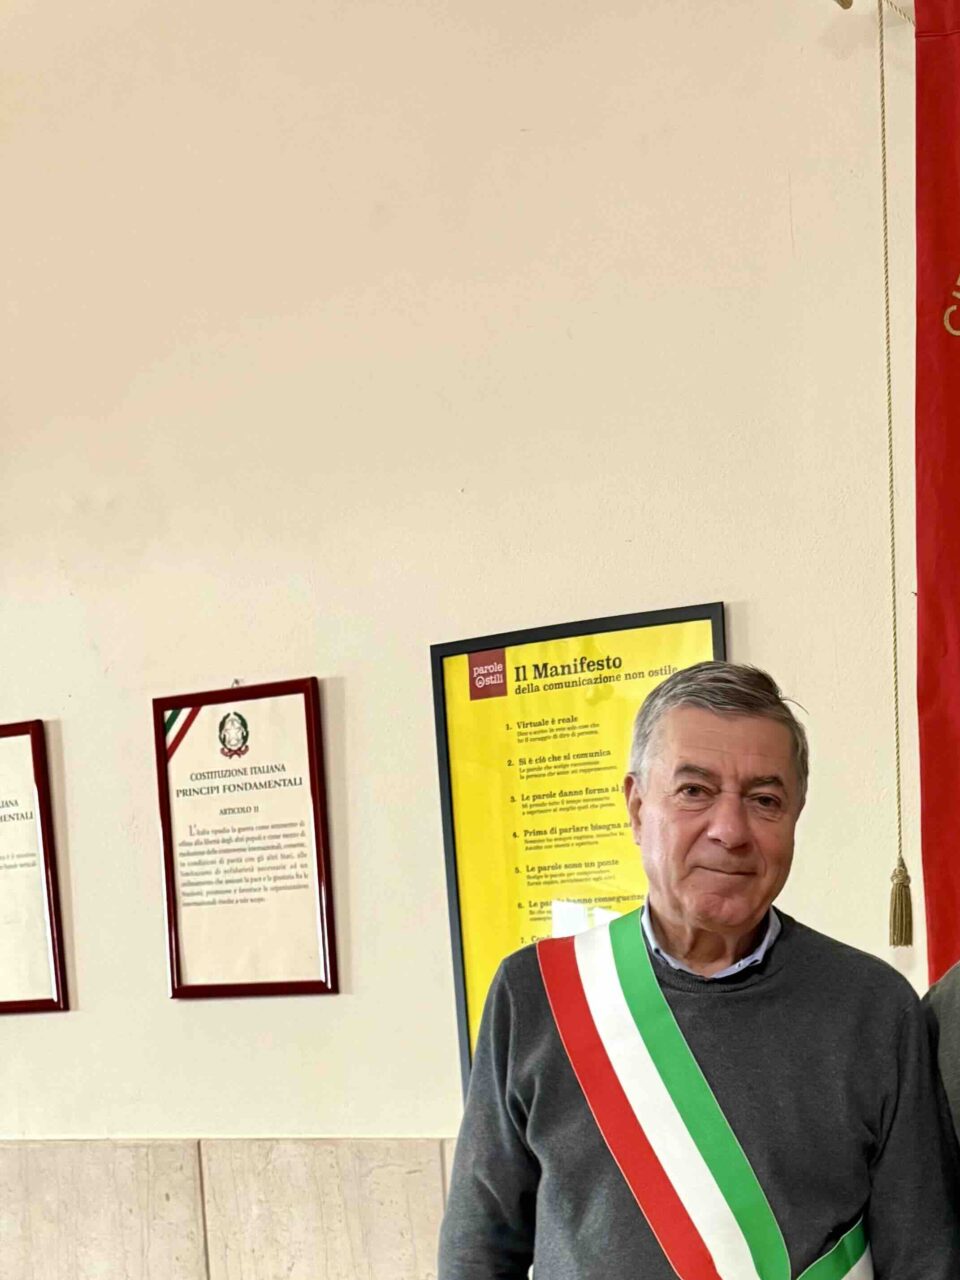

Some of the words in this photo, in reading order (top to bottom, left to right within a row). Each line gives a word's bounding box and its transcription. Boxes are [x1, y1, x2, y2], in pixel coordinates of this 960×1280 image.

[473, 662, 503, 677] parole
[514, 666, 528, 682] Il
[532, 655, 623, 680] Manifesto
[514, 684, 540, 695] della
[543, 674, 621, 691] comunicazione
[624, 670, 643, 681] non
[516, 718, 549, 729] Virtuale
[557, 715, 578, 725] reale
[548, 754, 561, 762] che
[572, 749, 611, 759] comunica
[190, 767, 248, 781] COSTITUZIONE
[250, 763, 286, 775] ITALIANA
[176, 785, 220, 798] PRINCIPI
[222, 777, 303, 793] FONDAMENTALI
[532, 792, 557, 803] parole
[558, 789, 583, 798] danno
[585, 787, 609, 795] forma
[219, 805, 252, 815] ARTICOLO
[523, 828, 548, 837] Prima
[549, 827, 557, 835] di
[559, 825, 588, 835] parlare
[538, 863, 562, 873] parole
[597, 859, 619, 869] ponte
